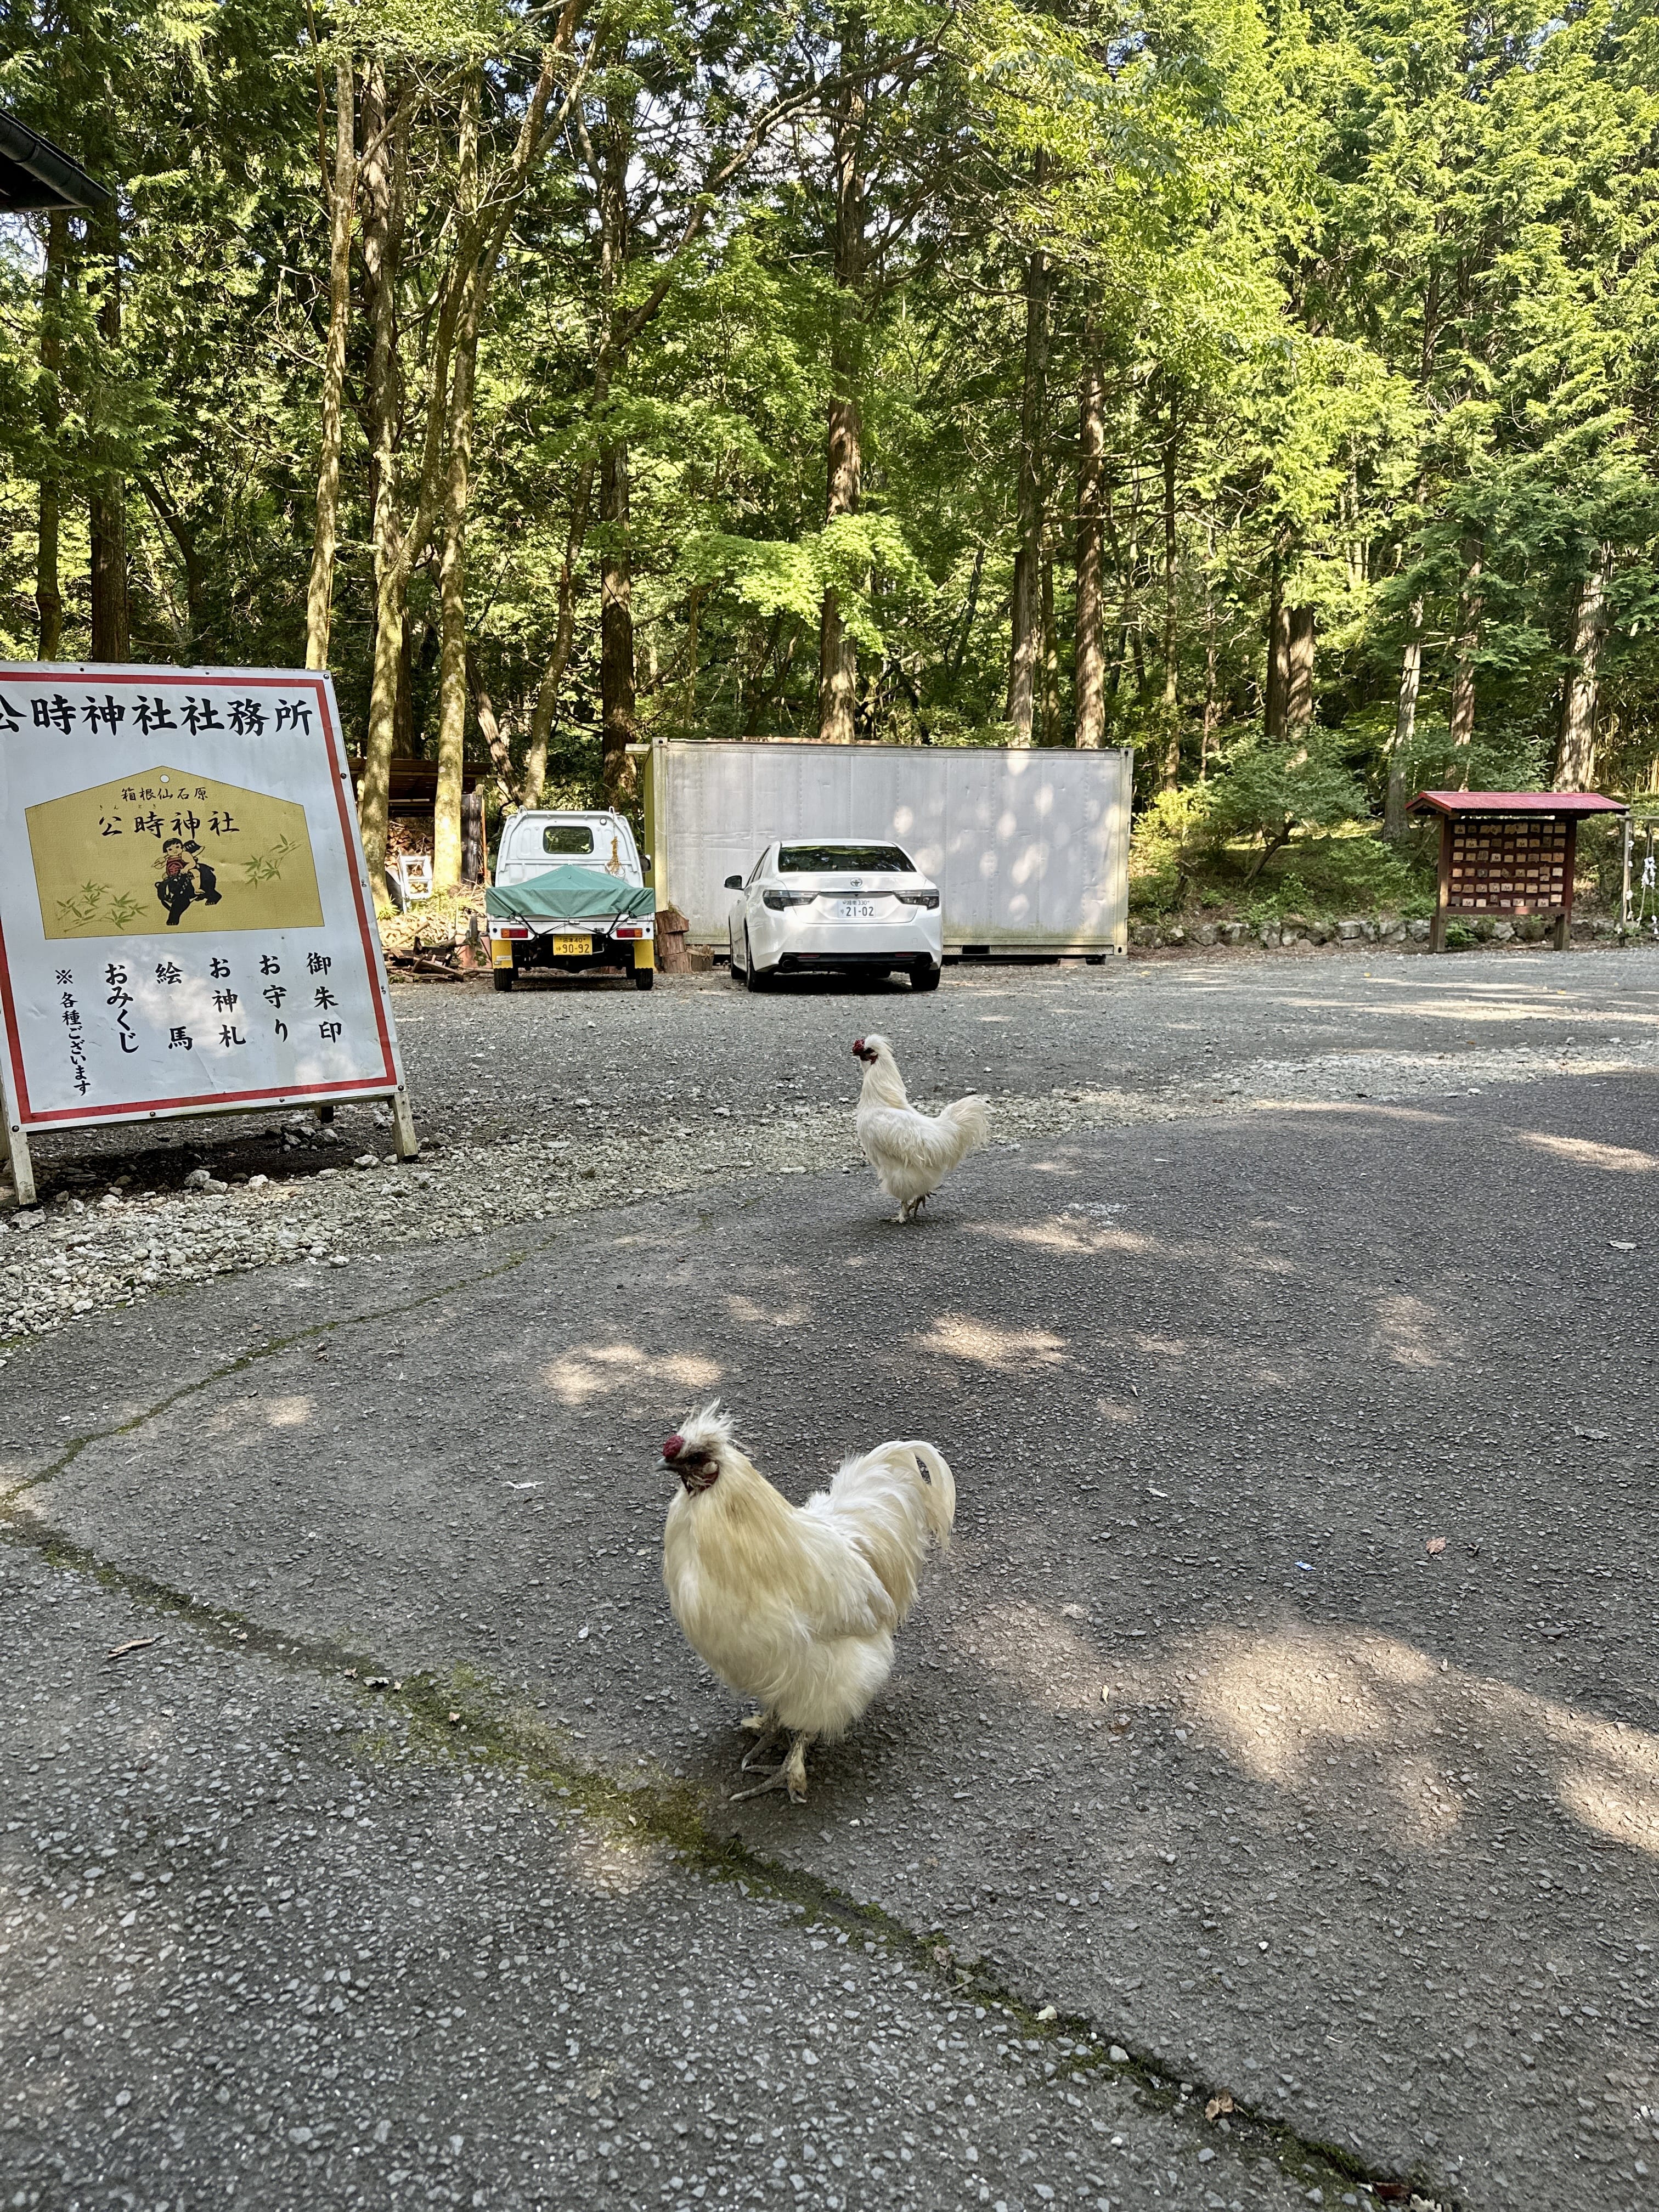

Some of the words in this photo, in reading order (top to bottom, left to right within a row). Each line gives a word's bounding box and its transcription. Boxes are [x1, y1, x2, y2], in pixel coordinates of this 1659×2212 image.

[0, 693, 313, 736] 公時神社社務所
[99, 810, 240, 839] 公時神社
[121, 787, 208, 802] 箱根仙石原
[846, 906, 874, 917] 21-02
[562, 944, 590, 953] 90-92
[104, 963, 139, 1053] おみくじ
[155, 961, 193, 1051] 絵馬
[209, 957, 246, 1048] お神札
[259, 955, 287, 1043] お守り
[306, 952, 342, 1043] 御朱印
